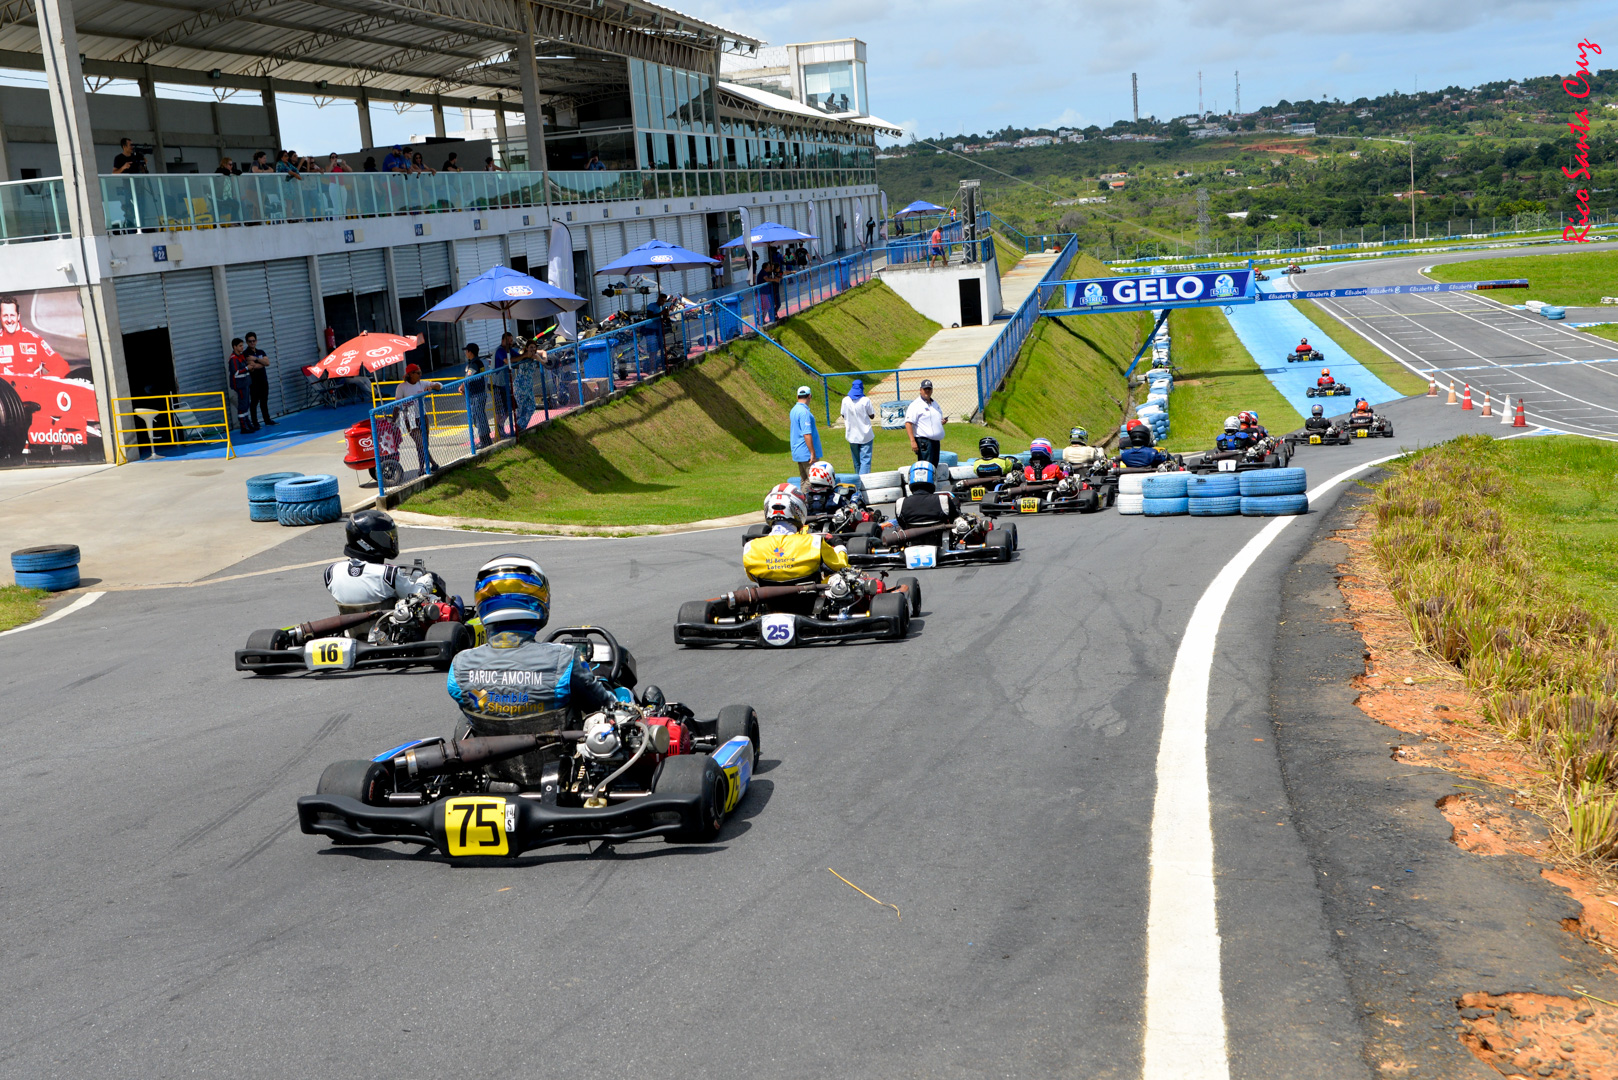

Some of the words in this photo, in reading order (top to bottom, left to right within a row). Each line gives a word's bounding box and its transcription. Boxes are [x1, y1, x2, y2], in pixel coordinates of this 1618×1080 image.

[1112, 275, 1204, 303] GELO
[1211, 287, 1238, 297] ESTRELA
[1081, 296, 1107, 304] ESTRELA
[371, 355, 399, 369] KIBON
[30, 429, 83, 444] vodafone
[972, 488, 984, 497] 80
[1022, 499, 1036, 510] 555
[766, 624, 790, 641] 25
[318, 642, 339, 663] 16
[468, 670, 498, 685] BARUC
[501, 670, 543, 686] AMORIM
[487, 702, 545, 716] Shopping
[453, 803, 501, 848] 75
